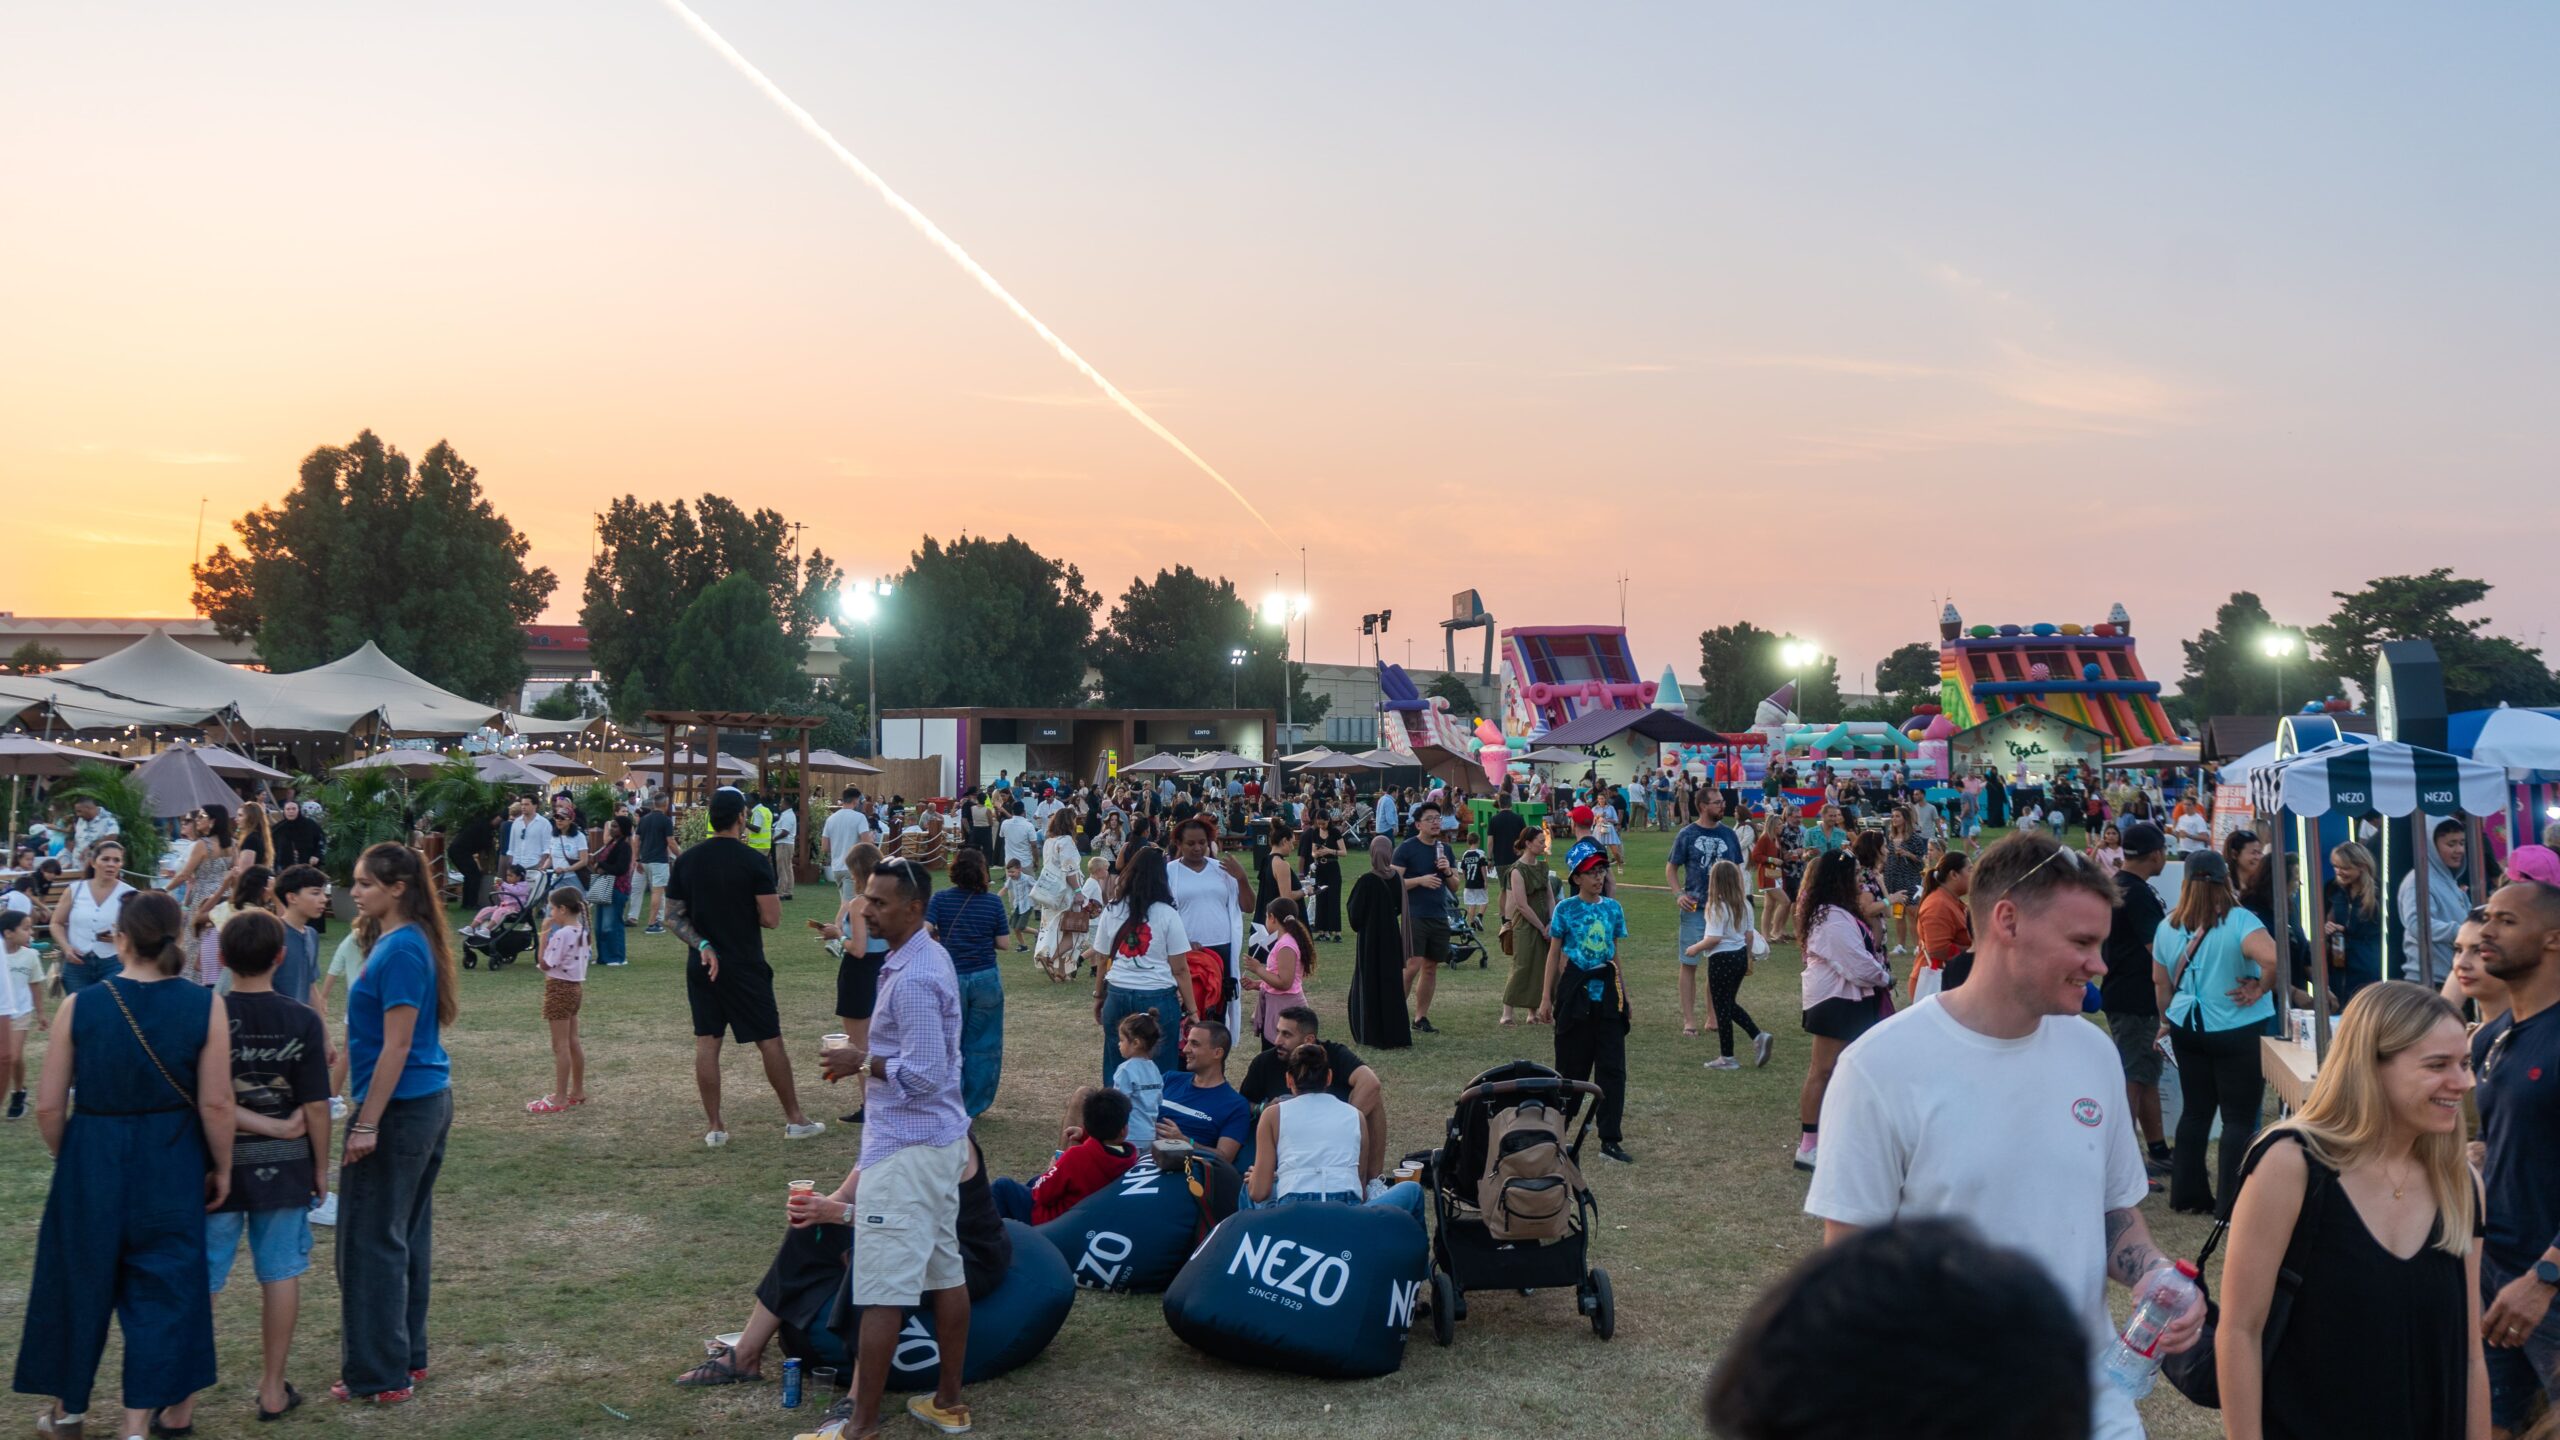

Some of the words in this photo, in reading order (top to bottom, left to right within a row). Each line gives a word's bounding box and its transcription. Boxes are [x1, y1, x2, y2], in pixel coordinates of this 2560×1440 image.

[2336, 791, 2366, 804] NEZO
[2423, 791, 2454, 803] NEZO
[1466, 864, 1478, 881] 17
[1194, 1111, 1212, 1121] HUGO
[1247, 1286, 1279, 1302] SINCE
[1280, 1296, 1303, 1311] 1929
[1386, 1278, 1422, 1329] NE
